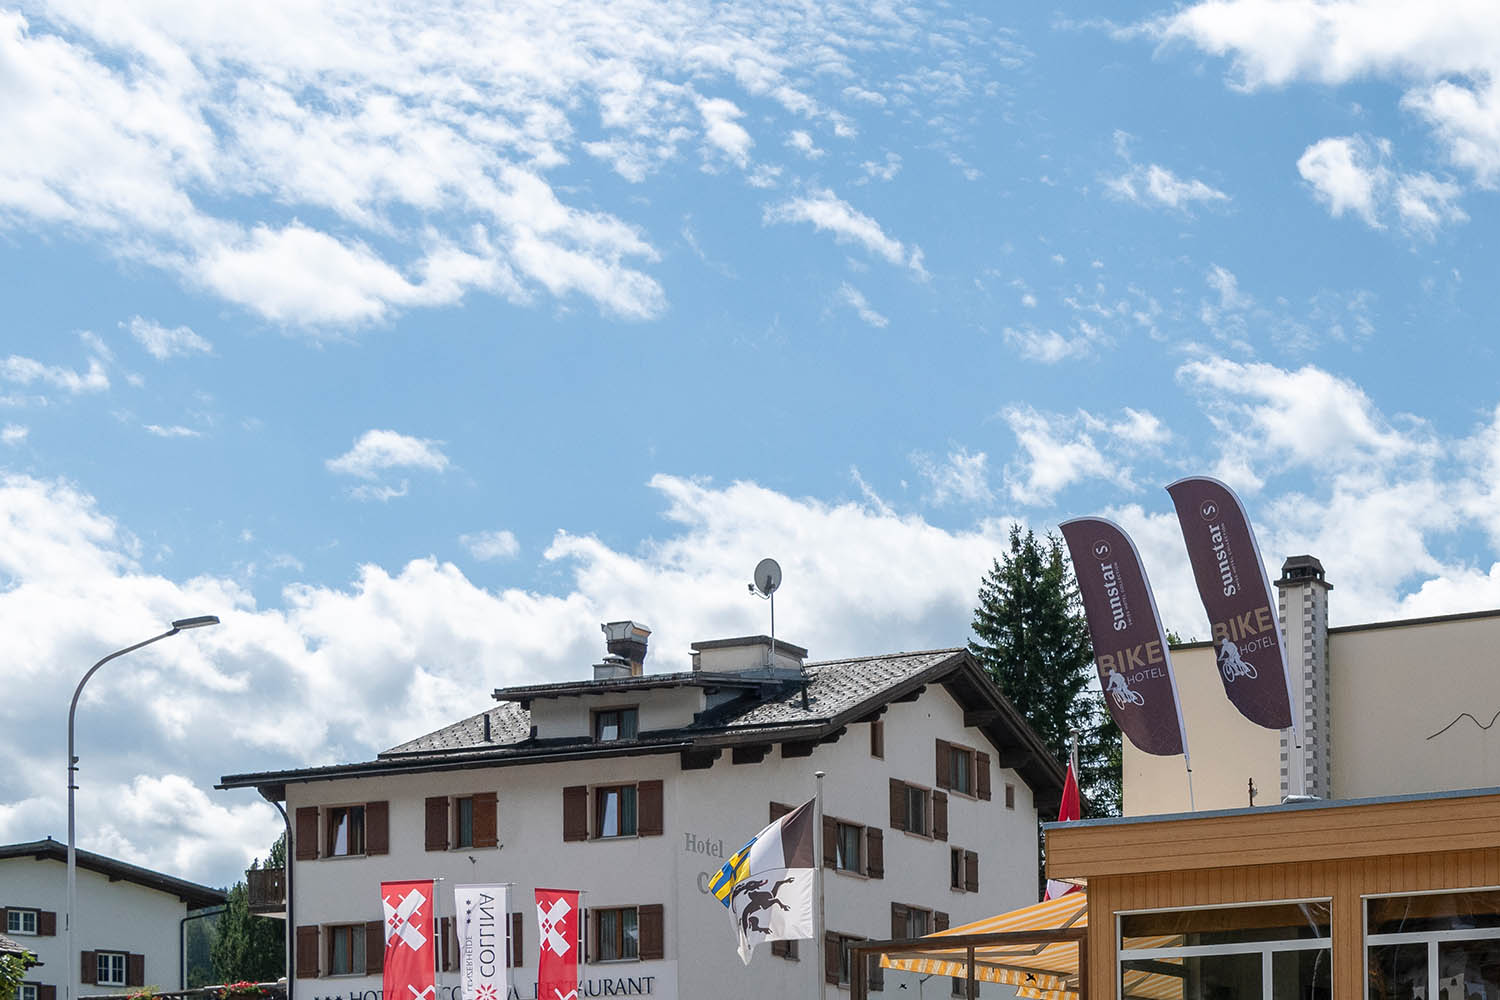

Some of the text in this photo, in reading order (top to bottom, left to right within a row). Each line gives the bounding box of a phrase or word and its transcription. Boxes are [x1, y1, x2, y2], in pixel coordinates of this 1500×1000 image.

[1213, 606, 1273, 646] BIKE
[1097, 639, 1164, 677] BIKE
[1239, 635, 1276, 655] HOTEL
[1126, 667, 1166, 685] HOTEL
[684, 832, 724, 858] Hotel
